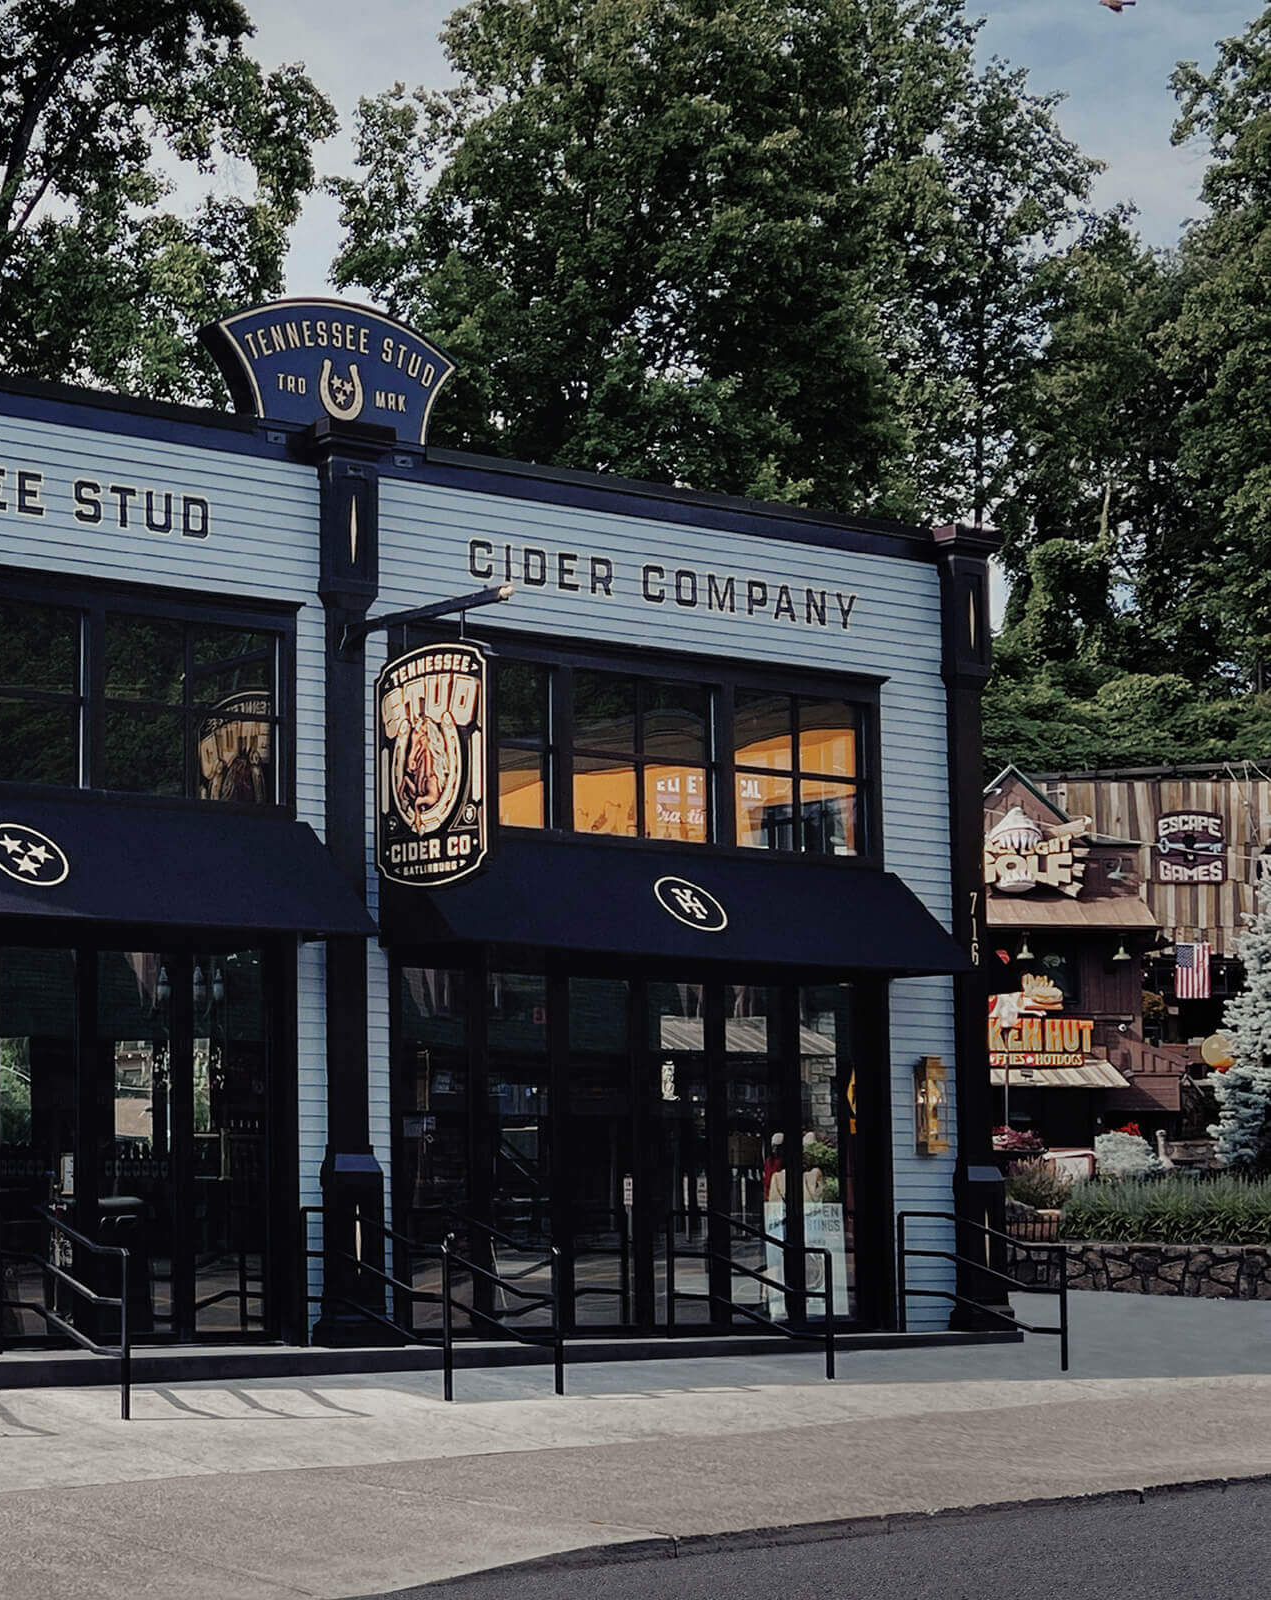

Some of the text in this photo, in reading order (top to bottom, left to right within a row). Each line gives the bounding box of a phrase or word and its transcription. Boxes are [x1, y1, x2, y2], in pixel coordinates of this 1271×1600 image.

[244, 320, 436, 388] TENNESSEE STUD
[374, 391, 407, 413] MRK
[71, 478, 211, 541] STUD
[467, 538, 858, 631] CIDER COMPANY
[390, 653, 471, 687] TENNESSEE
[381, 672, 480, 739] STUD
[1158, 815, 1222, 837] ESCAPE
[390, 835, 472, 863] CIDER CO
[1159, 861, 1222, 881] GAMES
[970, 892, 979, 966] 716
[1044, 1019, 1094, 1053] HUT
[1034, 1054, 1083, 1066] HOTDOGS
